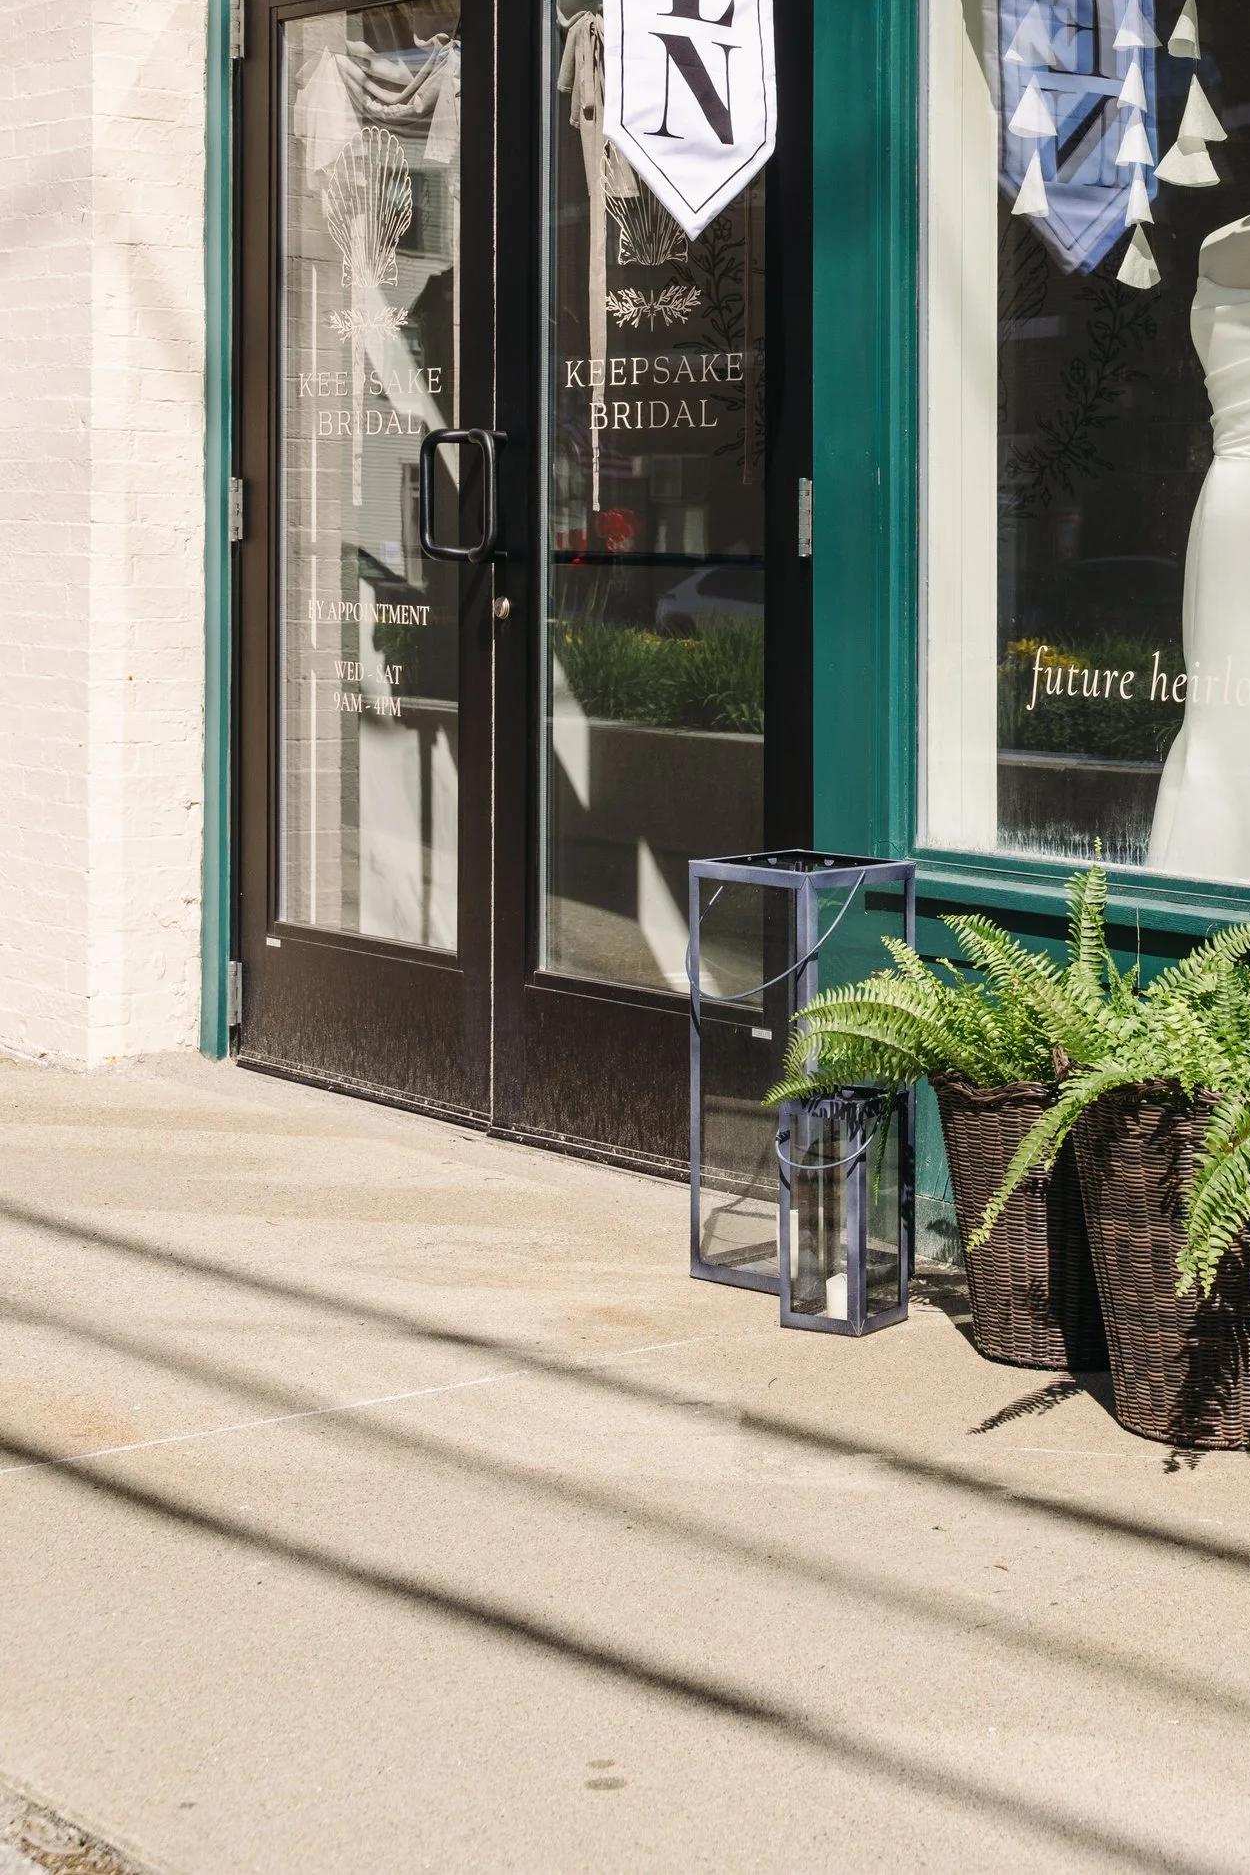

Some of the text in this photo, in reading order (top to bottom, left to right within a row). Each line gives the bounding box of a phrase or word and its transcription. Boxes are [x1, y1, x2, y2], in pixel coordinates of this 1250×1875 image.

[298, 367, 442, 397] KEEPSAKE
[565, 352, 744, 388] KEEPSAKE
[318, 409, 422, 436] BRIDAL
[589, 399, 718, 430] BRIDAL
[327, 600, 430, 626] APPOINTMENT
[334, 660, 364, 682] WED
[376, 664, 402, 685] SAT
[1026, 645, 1135, 711] future
[333, 692, 363, 713] 9AM
[374, 697, 402, 717] 4PM
